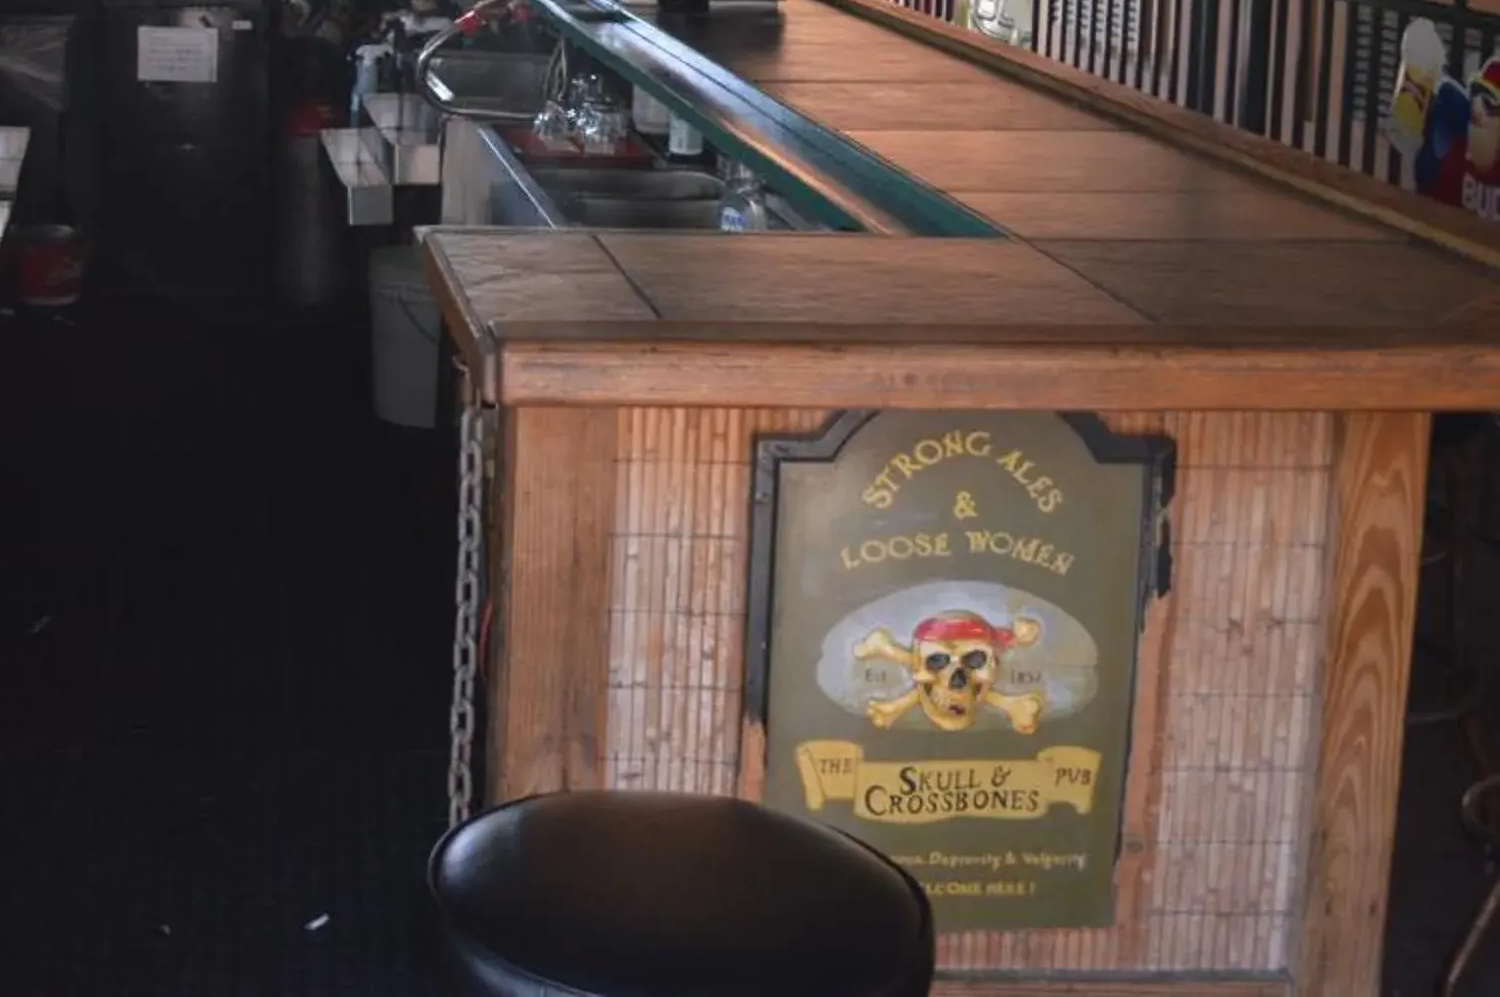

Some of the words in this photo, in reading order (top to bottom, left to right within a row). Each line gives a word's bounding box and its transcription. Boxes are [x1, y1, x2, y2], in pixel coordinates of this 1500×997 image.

[862, 430, 991, 510] STRONG
[997, 450, 1063, 514] ALES
[953, 491, 978, 519] &
[840, 531, 952, 570] LOOSE
[965, 529, 1076, 576] WOMEN
[820, 758, 853, 774] THE
[899, 766, 981, 795] SKULL
[991, 765, 1012, 788] &
[1054, 767, 1092, 787] PUB
[864, 785, 1040, 816] CROSSBONES
